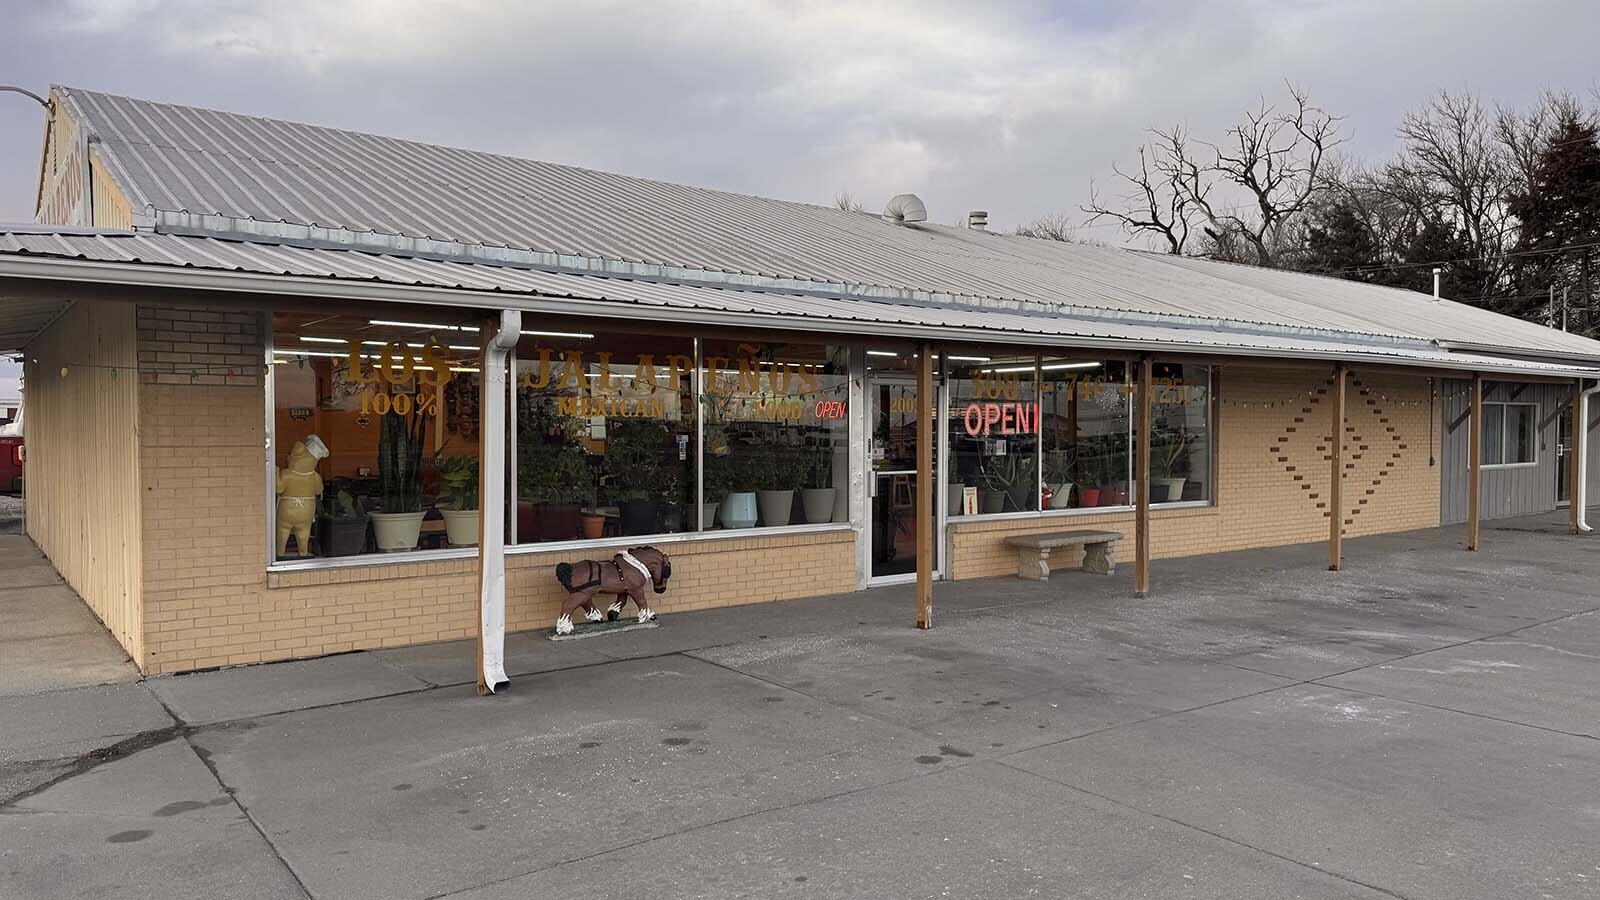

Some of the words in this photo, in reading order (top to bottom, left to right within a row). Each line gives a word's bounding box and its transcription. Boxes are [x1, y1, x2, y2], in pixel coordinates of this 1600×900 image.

[345, 338, 452, 386] LOS
[520, 343, 818, 395] JALAPEÑOS
[360, 393, 437, 415] 100%
[557, 396, 664, 418] MEXICAN
[815, 401, 846, 418] OPEN
